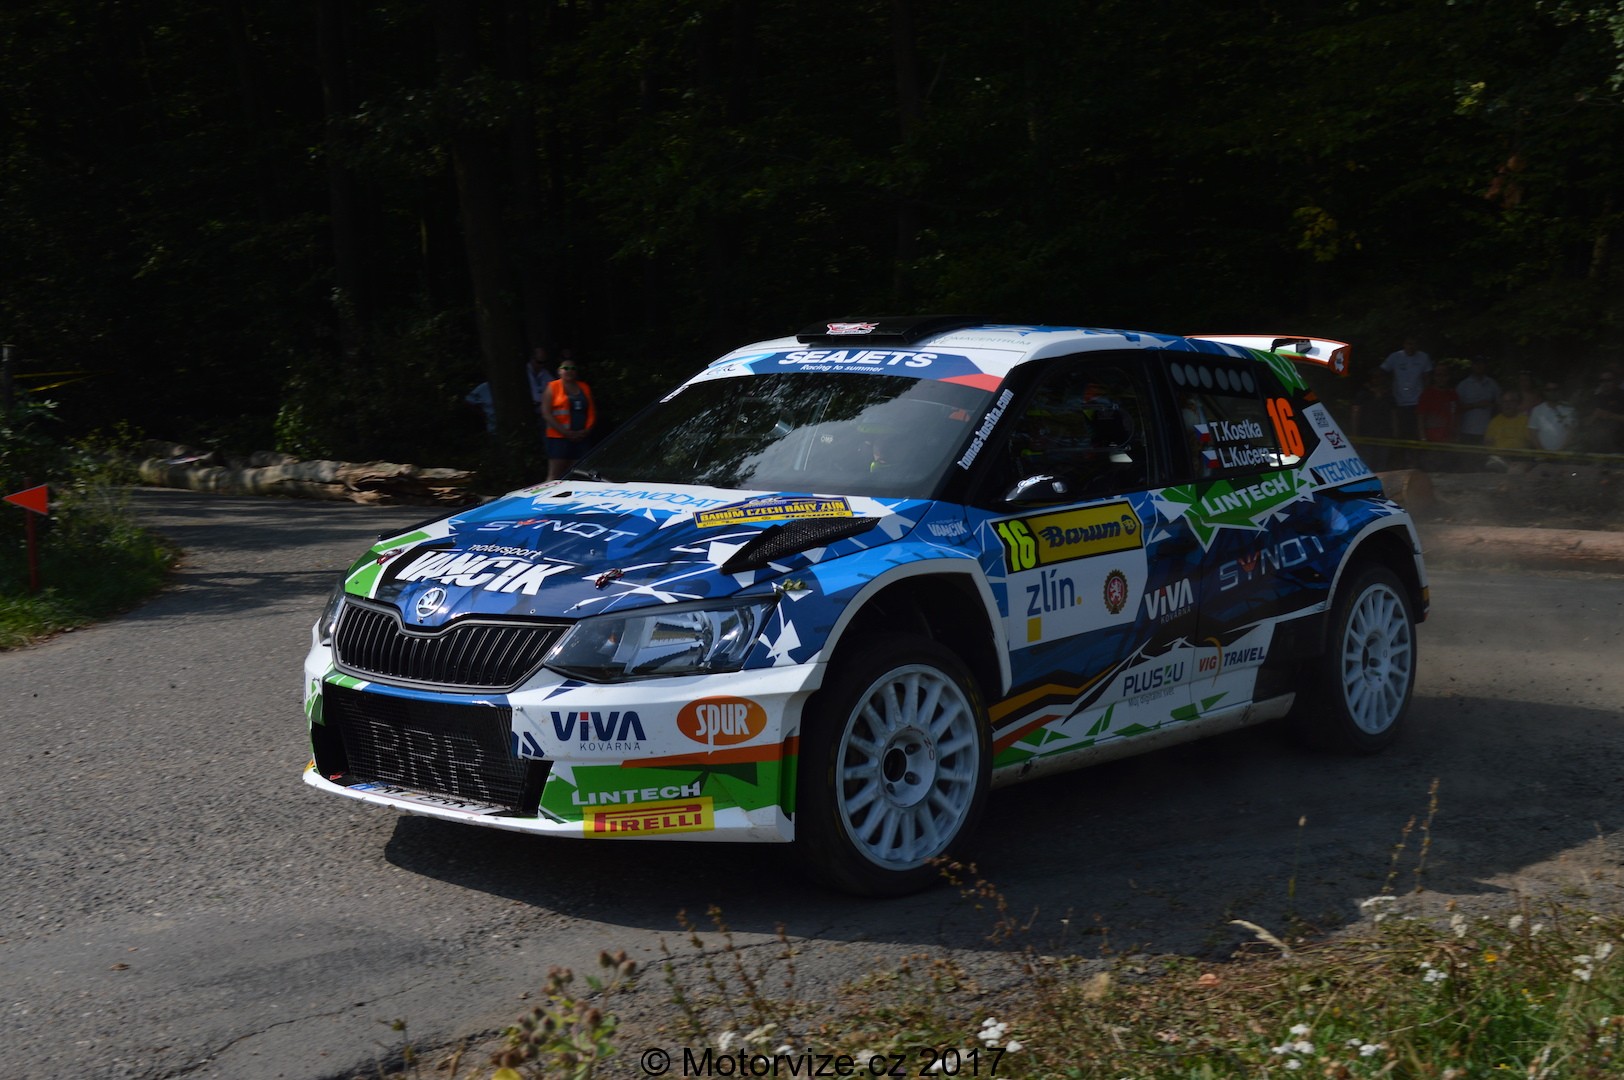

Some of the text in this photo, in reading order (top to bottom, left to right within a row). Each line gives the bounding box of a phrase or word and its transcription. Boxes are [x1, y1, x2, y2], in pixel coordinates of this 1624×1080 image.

[778, 350, 938, 368] SEAJETS
[800, 363, 884, 373] Racing to summer
[957, 388, 1015, 470] tomas-kostka.com
[1209, 419, 1264, 443] T.Kostka
[1265, 397, 1305, 458] 16
[1218, 443, 1275, 469] L.Kučera
[1201, 472, 1291, 518] LINTECH
[699, 508, 745, 523] BARUM
[746, 504, 784, 518] CZECH
[785, 501, 819, 514] RALLY
[476, 517, 640, 542] SYNOT
[1038, 520, 1122, 549] Barum
[467, 543, 543, 559] motorsport
[998, 519, 1038, 572] 16
[1219, 535, 1325, 592] SYNOT
[1199, 646, 1265, 673] VIG TRAVEL
[1122, 660, 1184, 697] PLUS4U
[571, 779, 701, 806] LINTECH
[593, 803, 703, 833] PIRELLI
